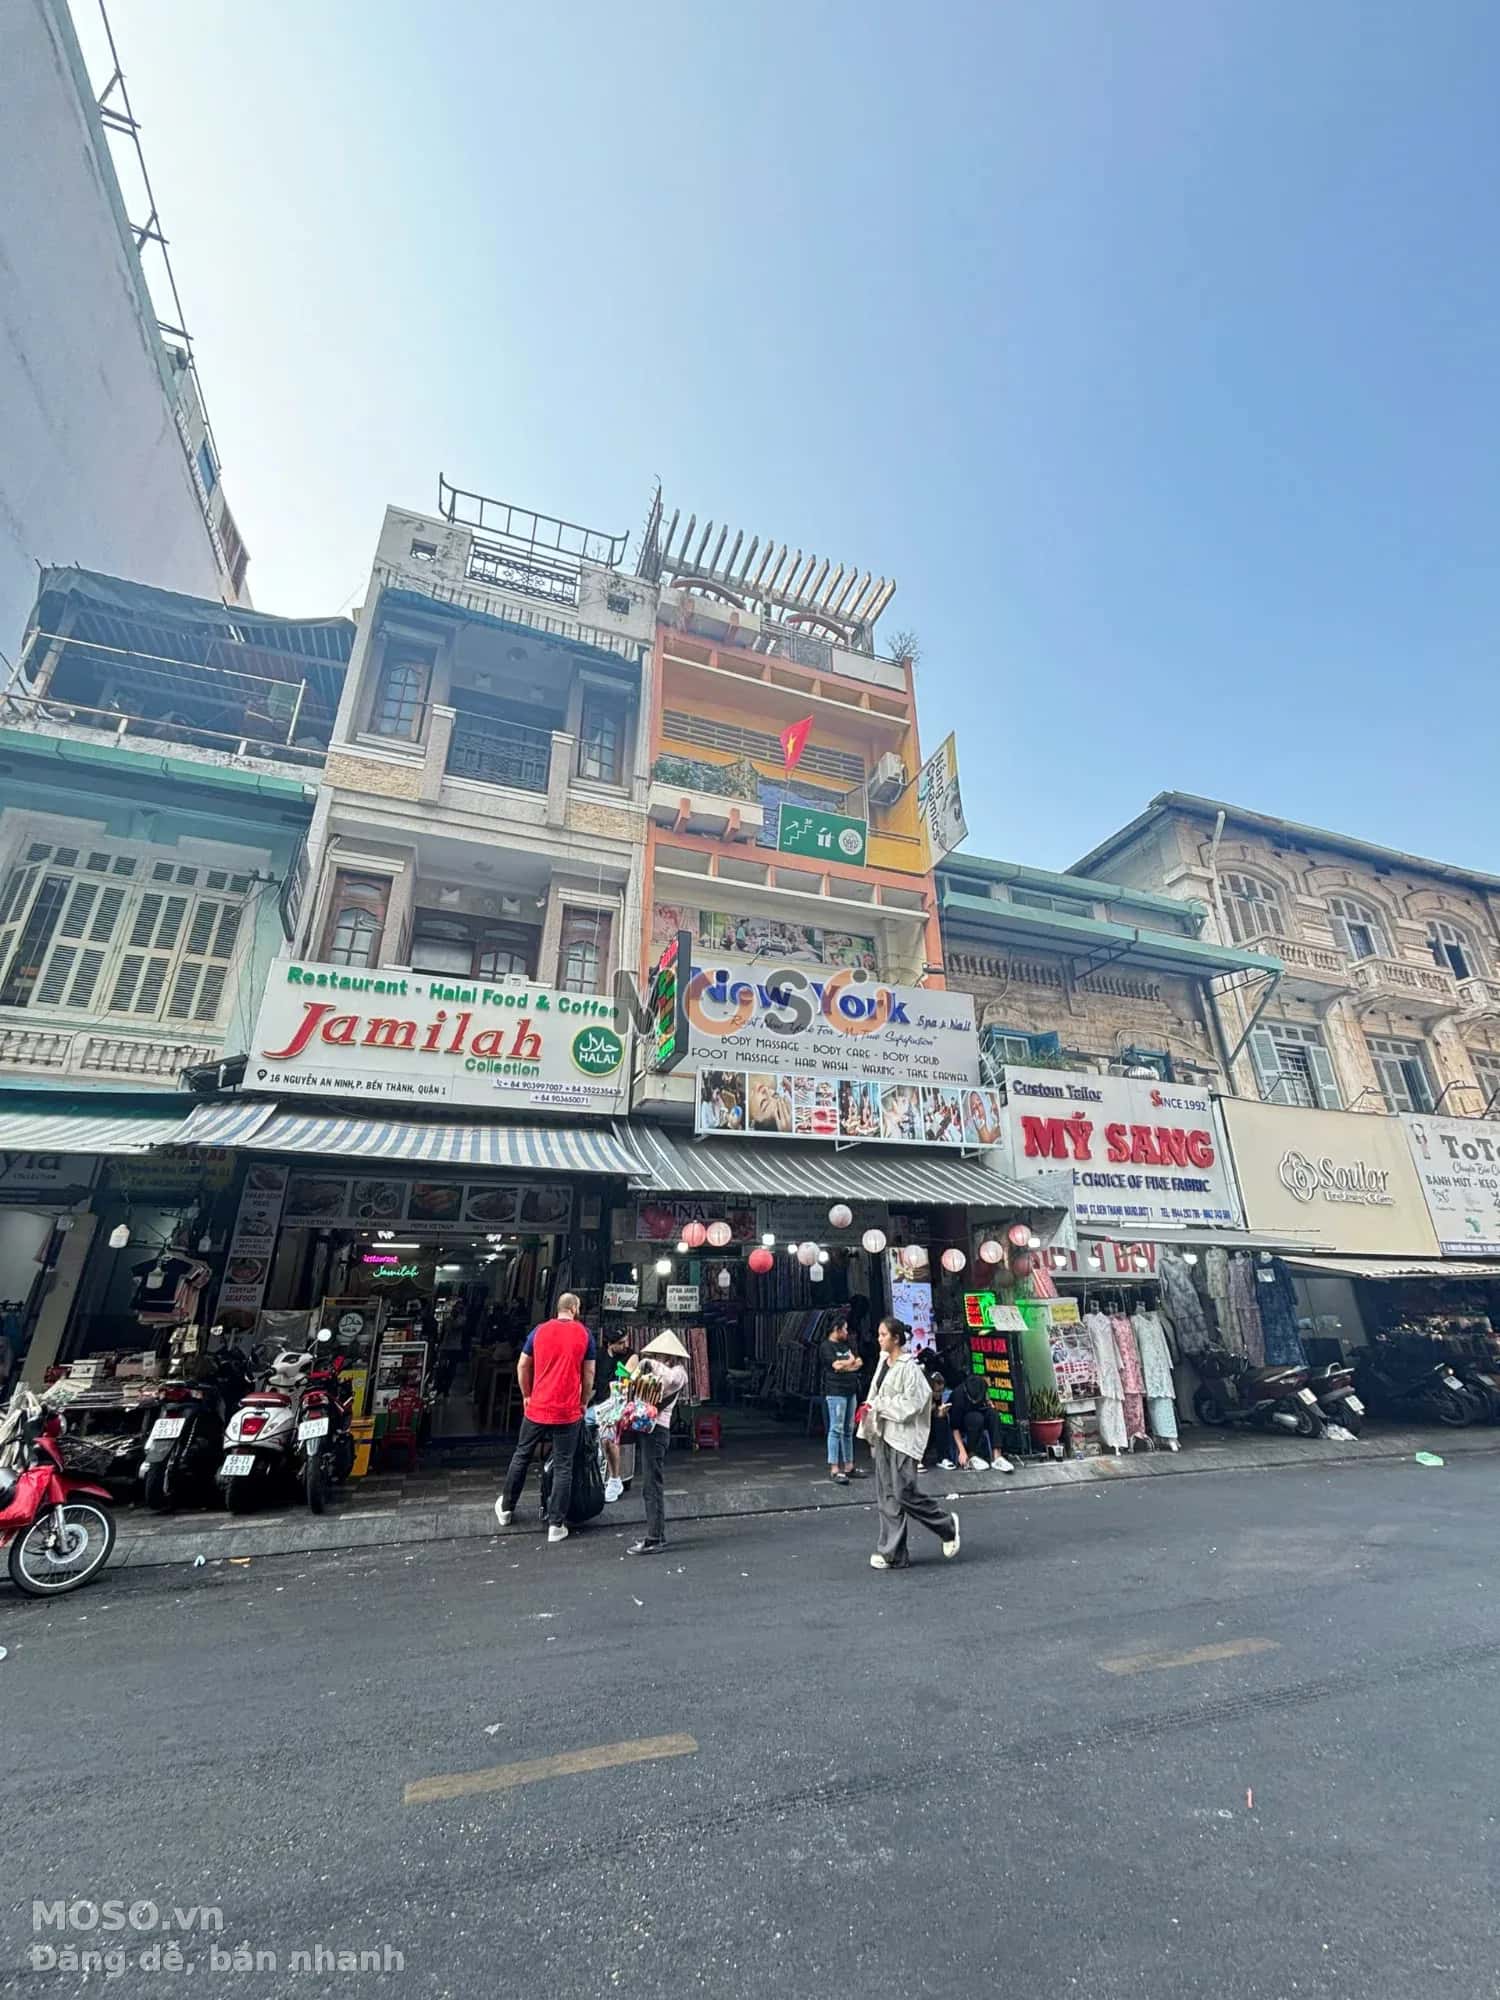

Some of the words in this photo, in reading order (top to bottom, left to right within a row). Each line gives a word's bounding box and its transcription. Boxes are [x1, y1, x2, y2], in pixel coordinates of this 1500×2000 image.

[287, 966, 408, 995] Restaurant
[429, 982, 477, 1004] Halal
[482, 988, 529, 1009] Food
[536, 994, 550, 1011] &
[558, 997, 619, 1018] Coffee
[261, 1001, 543, 1061] Jamilah
[915, 1015, 938, 1030] Spa
[578, 1052, 618, 1065] HALAL
[691, 1047, 728, 1059] FOOT
[735, 1052, 780, 1064] MASSAGE
[794, 1057, 817, 1068] HAIR
[822, 1060, 848, 1071] WASH
[862, 1063, 895, 1076] WAXING
[907, 1068, 929, 1079] TAKE
[932, 1070, 969, 1083] EARWAX
[721, 1035, 751, 1046] BODY
[756, 1040, 800, 1052] MASSAGE
[813, 1045, 841, 1056] BODY
[846, 1048, 870, 1058] CARE
[883, 1051, 909, 1062] BODY
[914, 1055, 940, 1065] SCRUB
[464, 1057, 540, 1077] Collection
[270, 1073, 281, 1083] 16
[283, 1072, 318, 1086] NGUYỄN
[320, 1076, 332, 1087] AN
[366, 1079, 384, 1092] BẾN
[418, 1084, 440, 1096] QUẬN
[441, 1086, 447, 1096] 1
[1013, 1079, 1064, 1097] Custom
[1184, 1099, 1207, 1111] 1992
[1021, 1111, 1094, 1161] MỸ
[1104, 1122, 1215, 1168] SANG
[1081, 1171, 1128, 1189] CHOICE
[1128, 1174, 1143, 1189] OF
[1145, 1175, 1171, 1191] FINE
[1171, 1177, 1211, 1193] FABRIC
